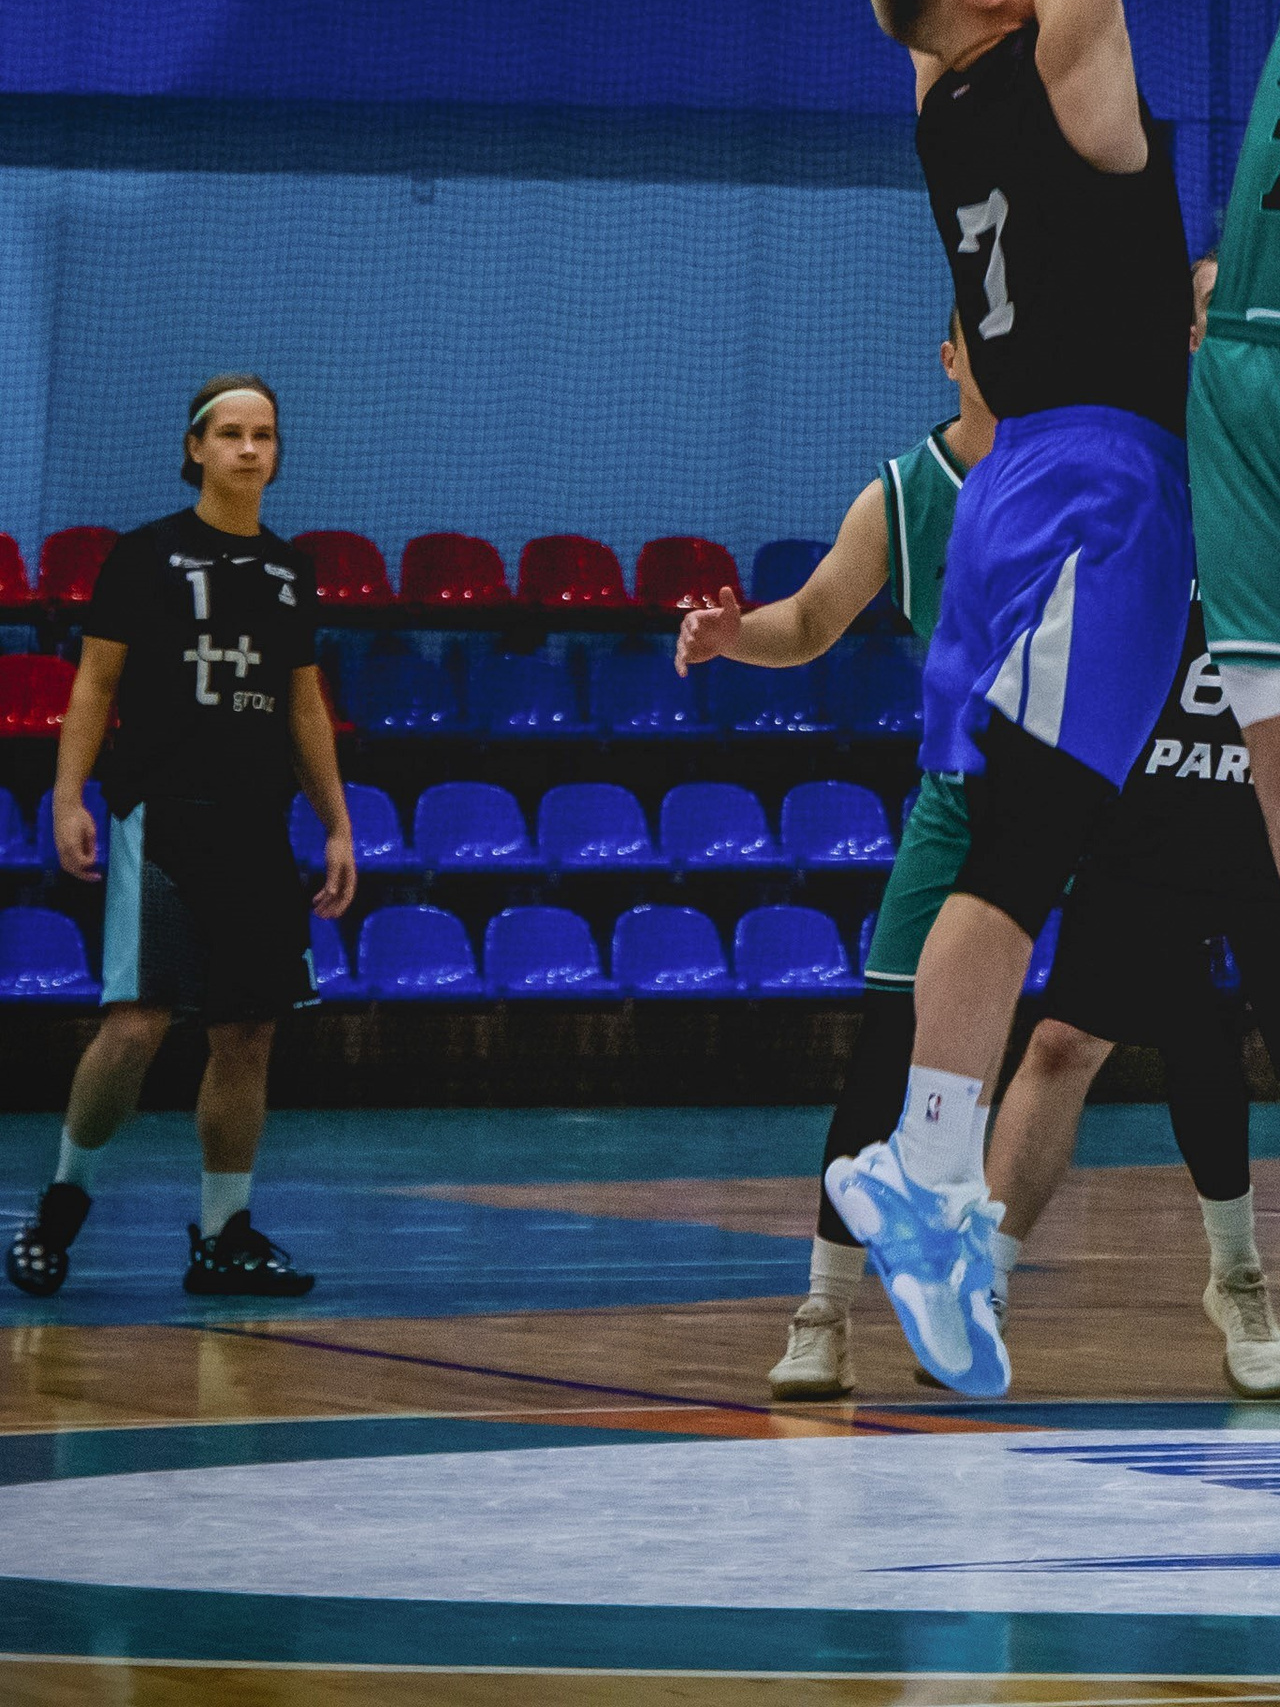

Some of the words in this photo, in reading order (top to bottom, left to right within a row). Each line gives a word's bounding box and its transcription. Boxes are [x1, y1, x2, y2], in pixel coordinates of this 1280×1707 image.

[955, 187, 1016, 341] 7
[185, 569, 211, 620] 1
[1144, 738, 1255, 785] PAR
[301, 947, 318, 991] 1
